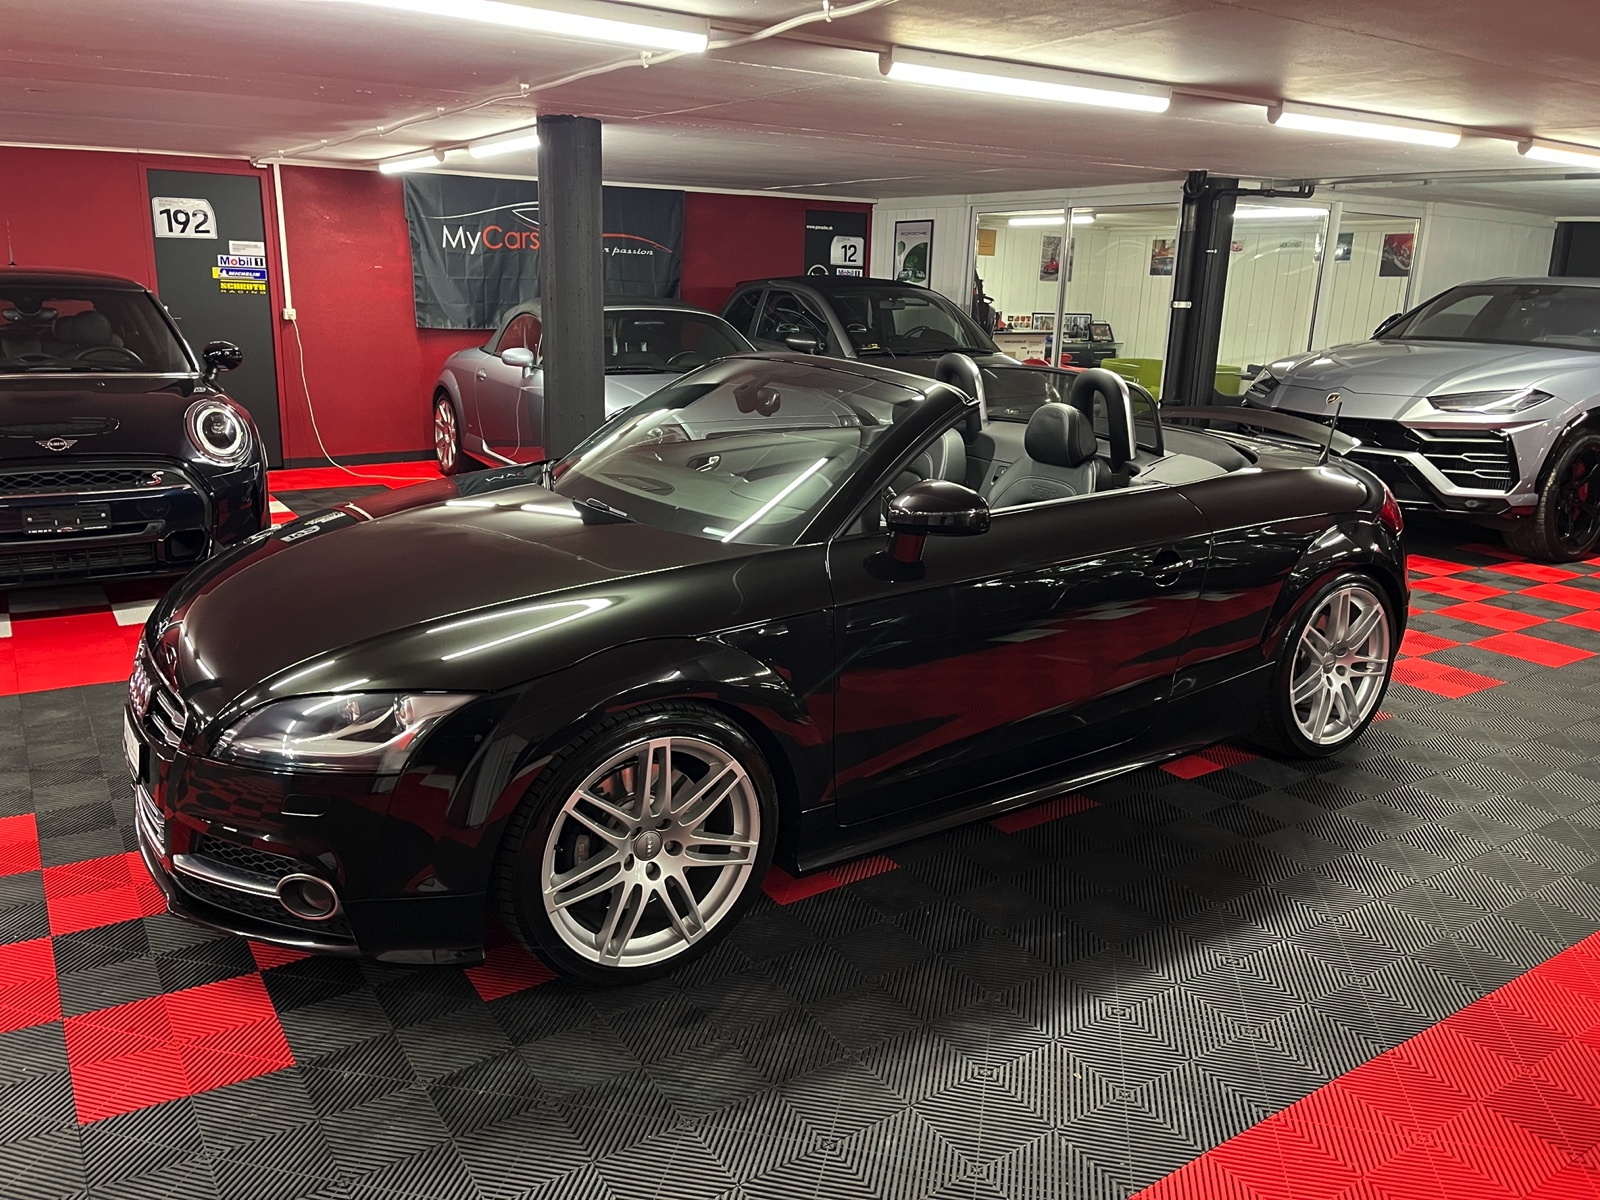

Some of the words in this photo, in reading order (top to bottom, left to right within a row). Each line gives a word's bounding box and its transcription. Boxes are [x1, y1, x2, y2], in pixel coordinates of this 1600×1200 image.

[159, 208, 211, 234] 192
[442, 225, 540, 255] MyCars
[611, 246, 654, 256] passion
[841, 244, 858, 263] 12
[219, 256, 253, 267] Mobil
[254, 257, 264, 267] 1
[220, 282, 266, 290] SCHROTH
